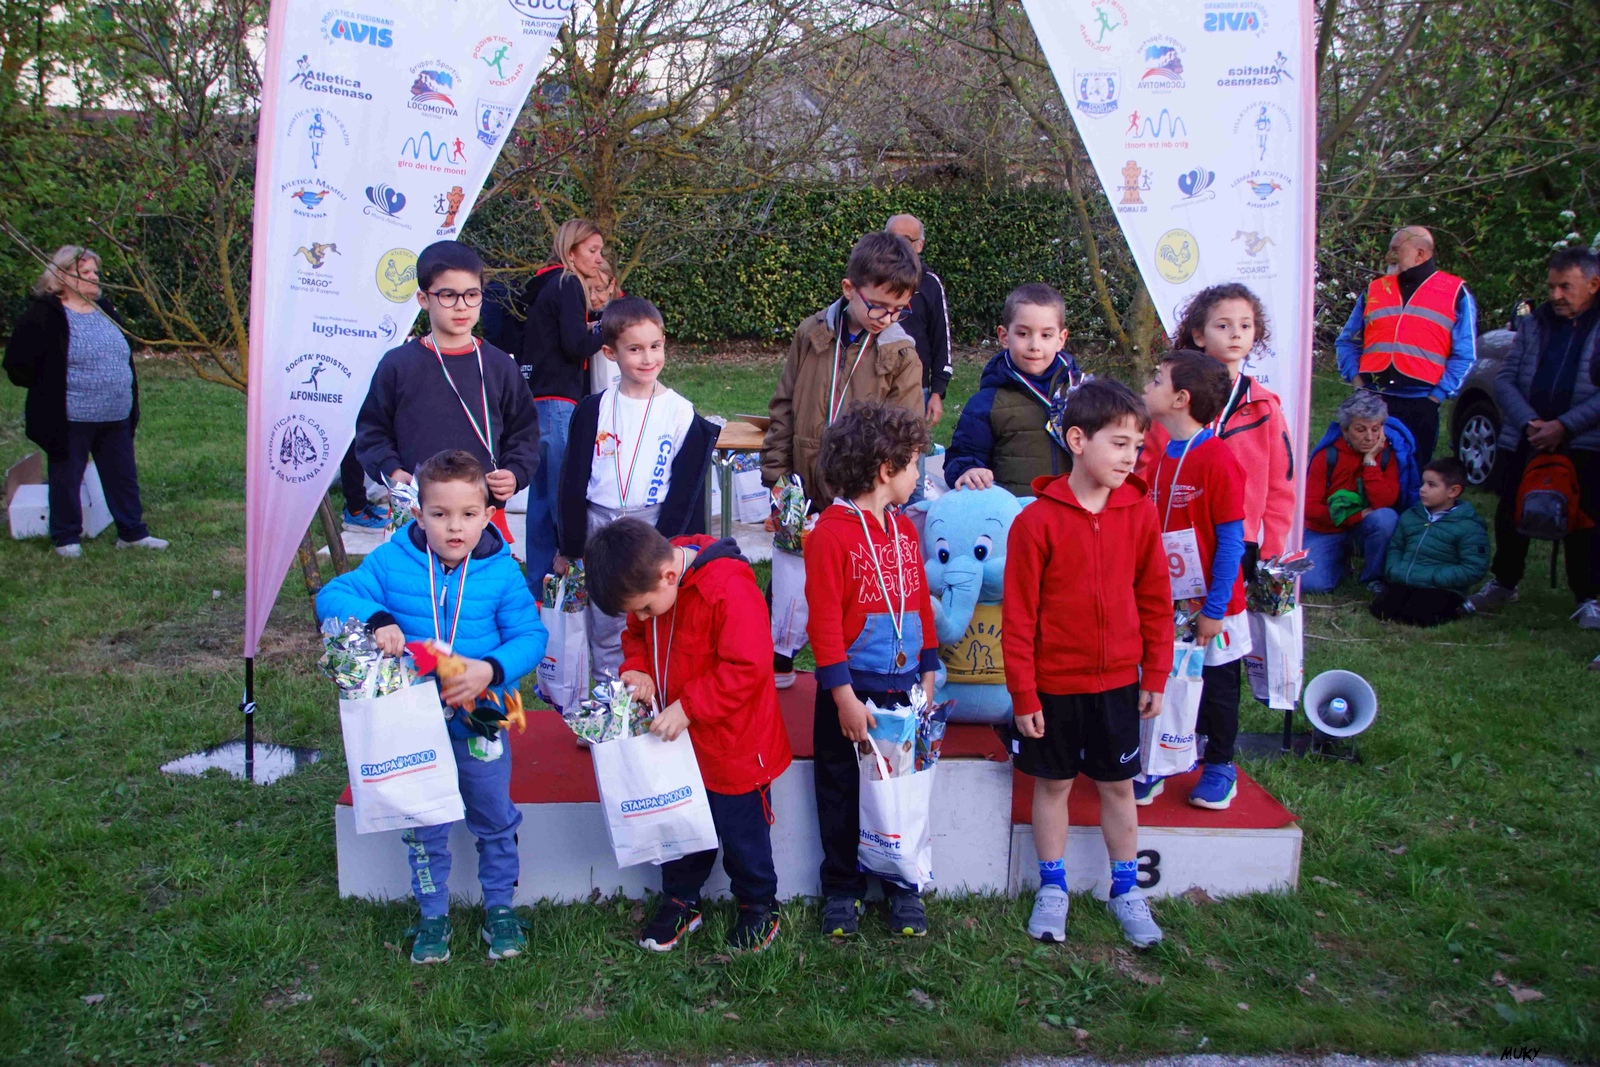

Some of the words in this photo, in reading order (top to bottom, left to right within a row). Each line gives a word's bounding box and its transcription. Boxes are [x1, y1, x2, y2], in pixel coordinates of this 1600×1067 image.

[331, 19, 394, 49] AVIS
[473, 35, 513, 60] PODISTICA
[306, 70, 362, 89] Atletica
[489, 63, 524, 87] VOLTANA
[304, 80, 373, 101] Castenaso
[407, 101, 459, 117] LOCOMOTIVA
[398, 160, 413, 169] giro
[415, 162, 428, 170] dei
[430, 164, 442, 173] tre
[443, 167, 467, 176] monti
[312, 321, 378, 339] lughesina
[316, 353, 352, 379] PODISTICA
[290, 391, 343, 404] ALFONSINESE
[1136, 849, 1161, 889] 3
